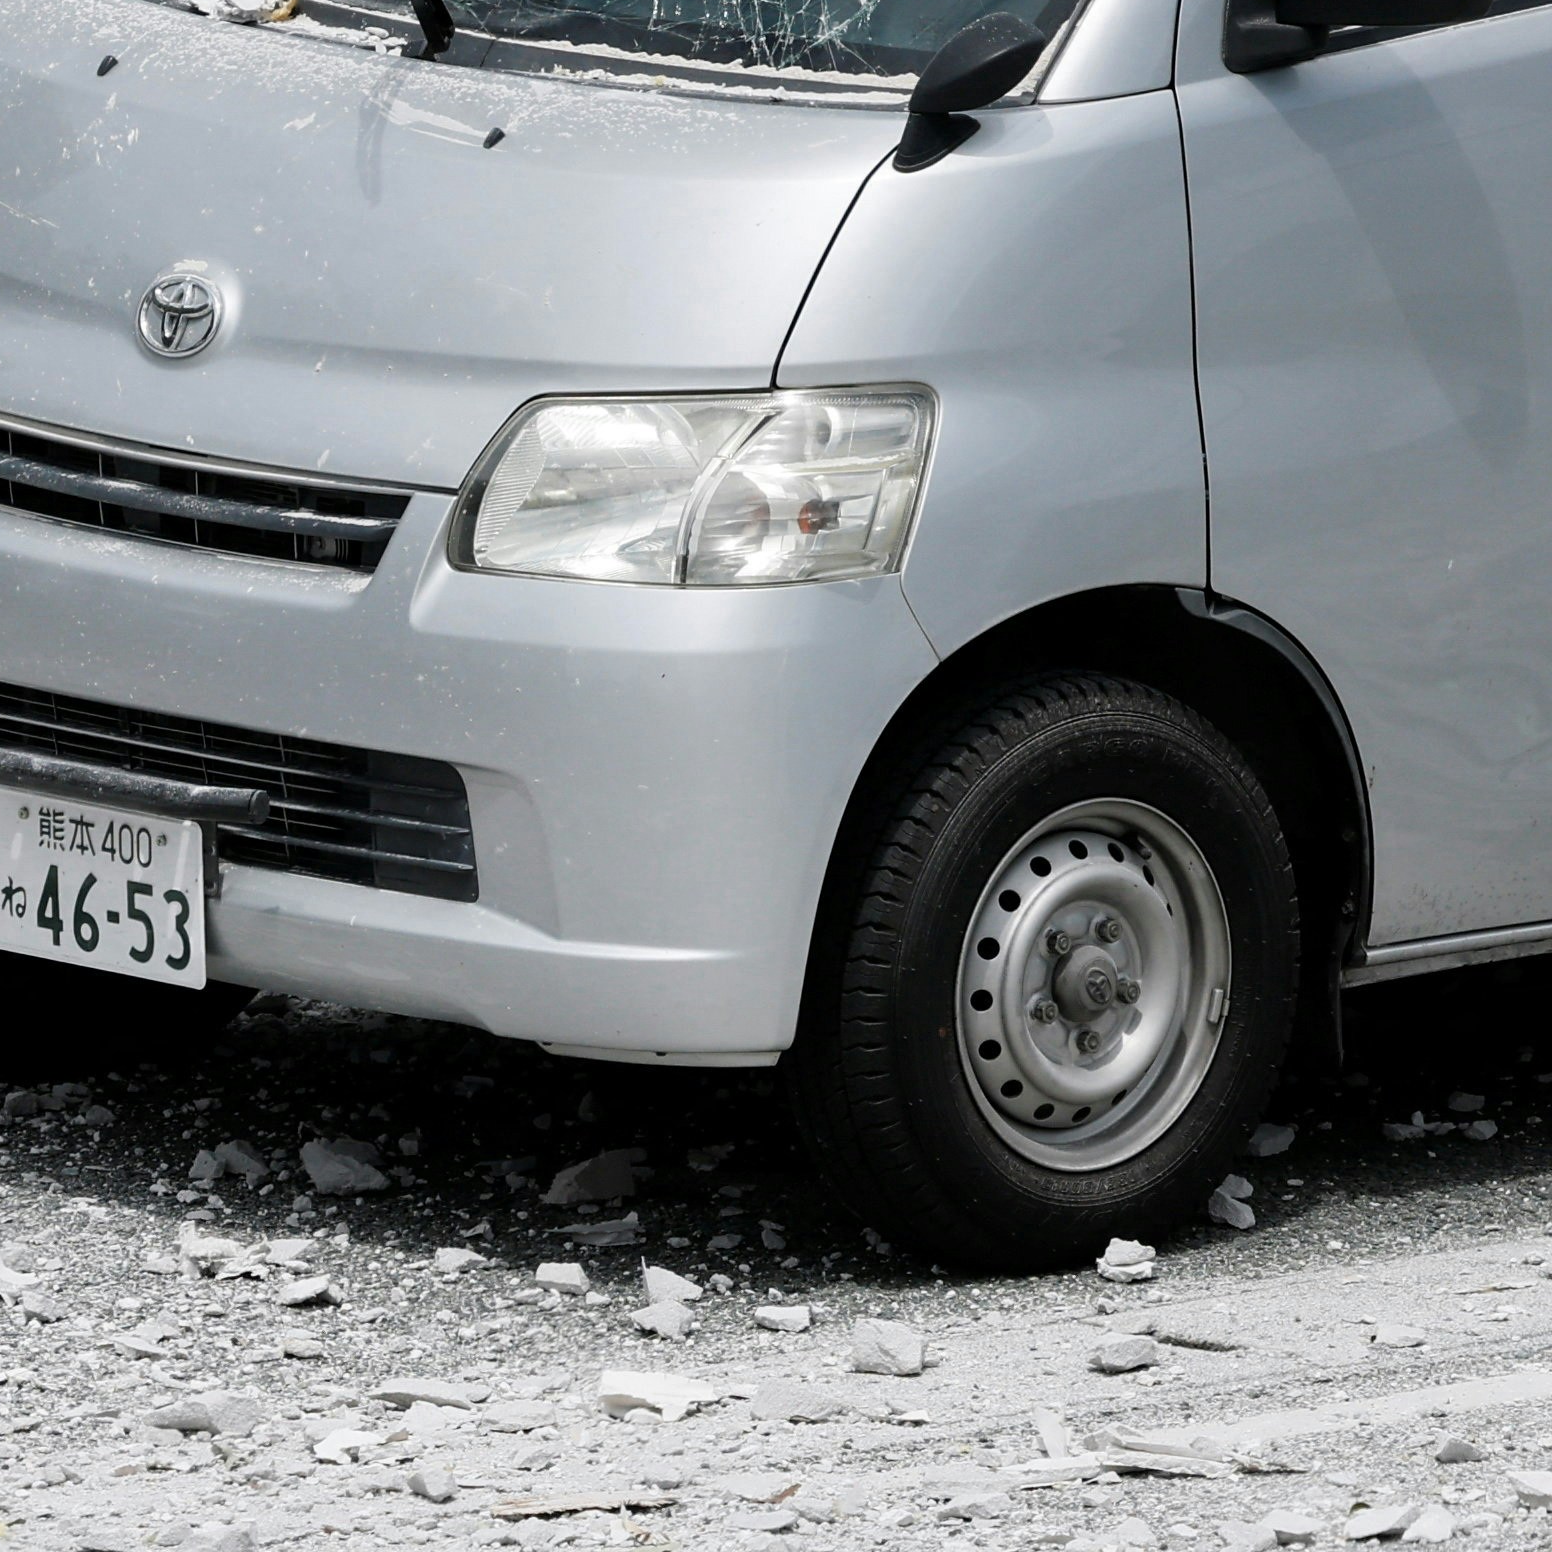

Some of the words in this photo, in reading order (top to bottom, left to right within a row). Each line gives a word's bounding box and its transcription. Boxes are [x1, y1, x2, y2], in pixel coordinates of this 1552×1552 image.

[37, 807, 153, 868] 熊本400
[1, 875, 28, 919] ね
[36, 864, 192, 972] 46-53
